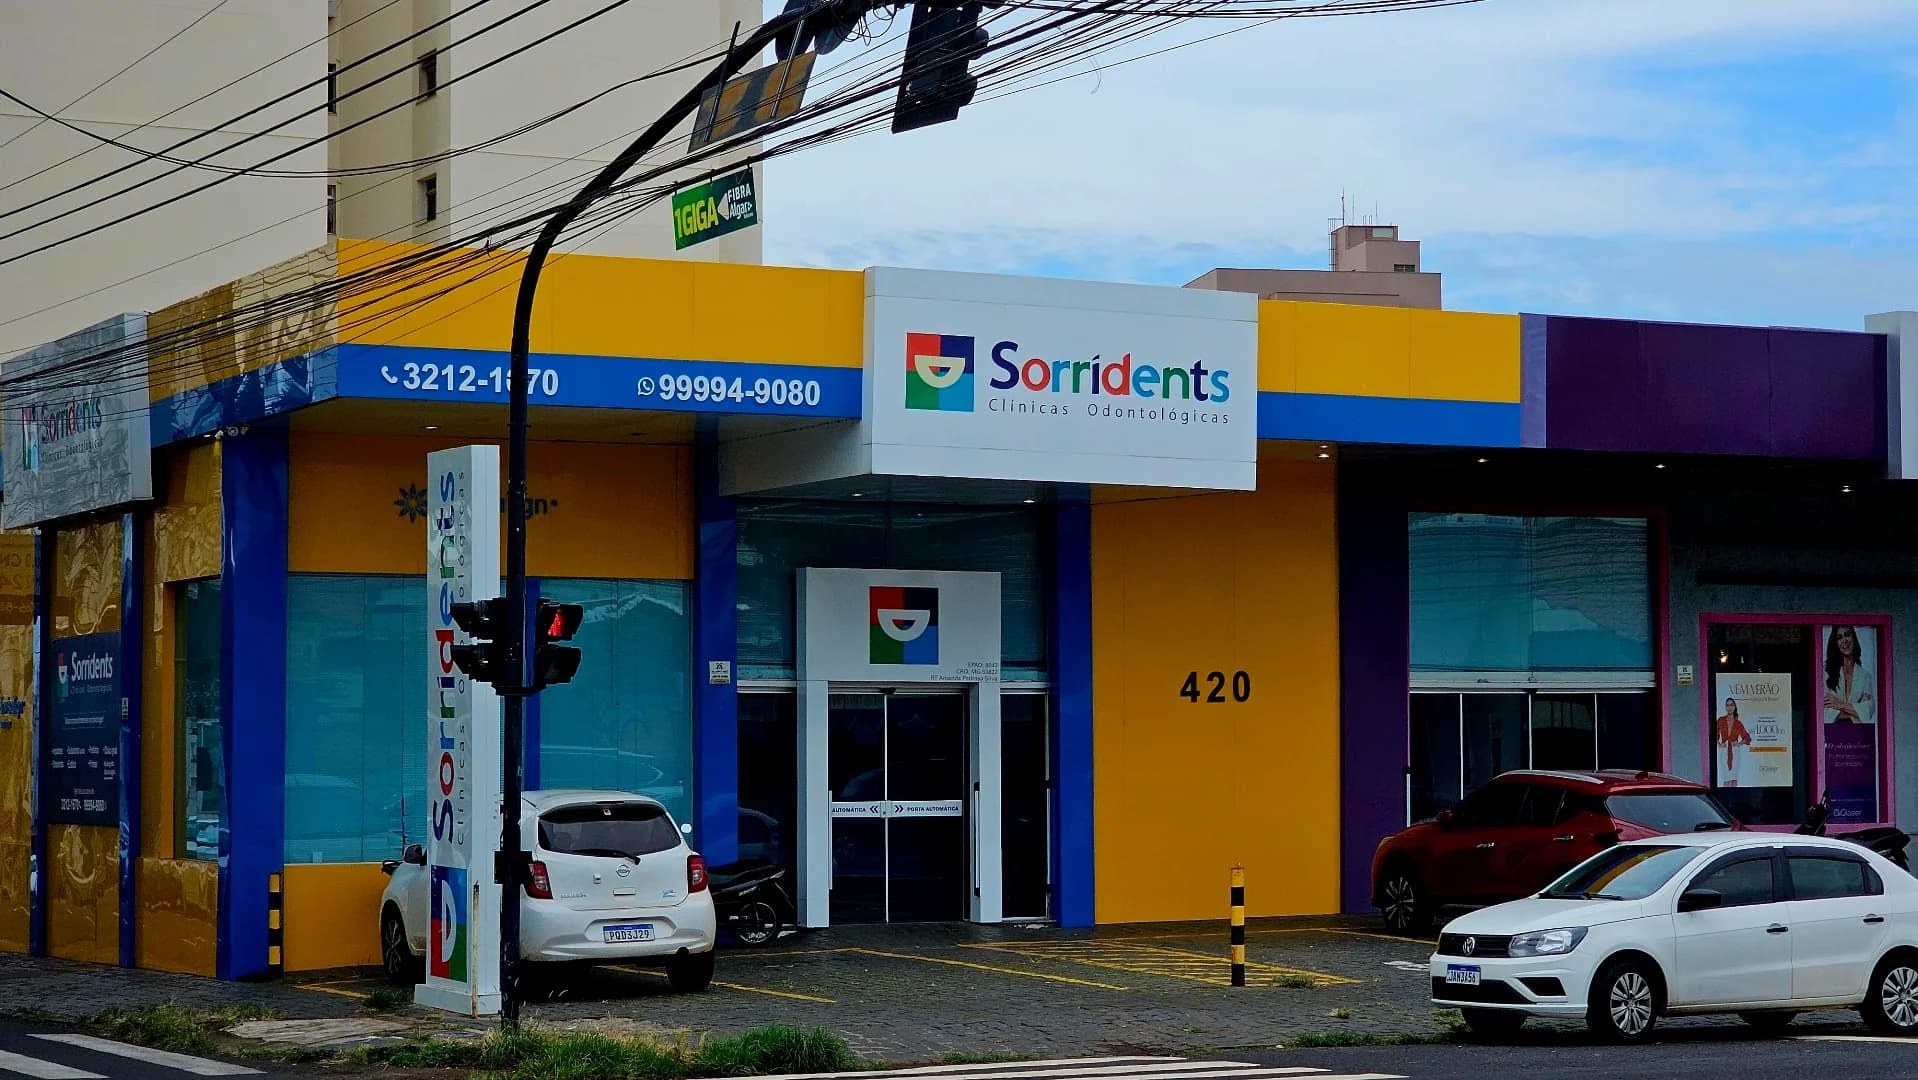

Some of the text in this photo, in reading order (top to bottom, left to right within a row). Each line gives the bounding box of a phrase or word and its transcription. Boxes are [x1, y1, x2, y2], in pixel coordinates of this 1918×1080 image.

[727, 183, 752, 203] FIBRA
[658, 373, 821, 407] 99994-9080
[1087, 403, 1229, 425] Odontológicas
[1179, 670, 1251, 703] 420
